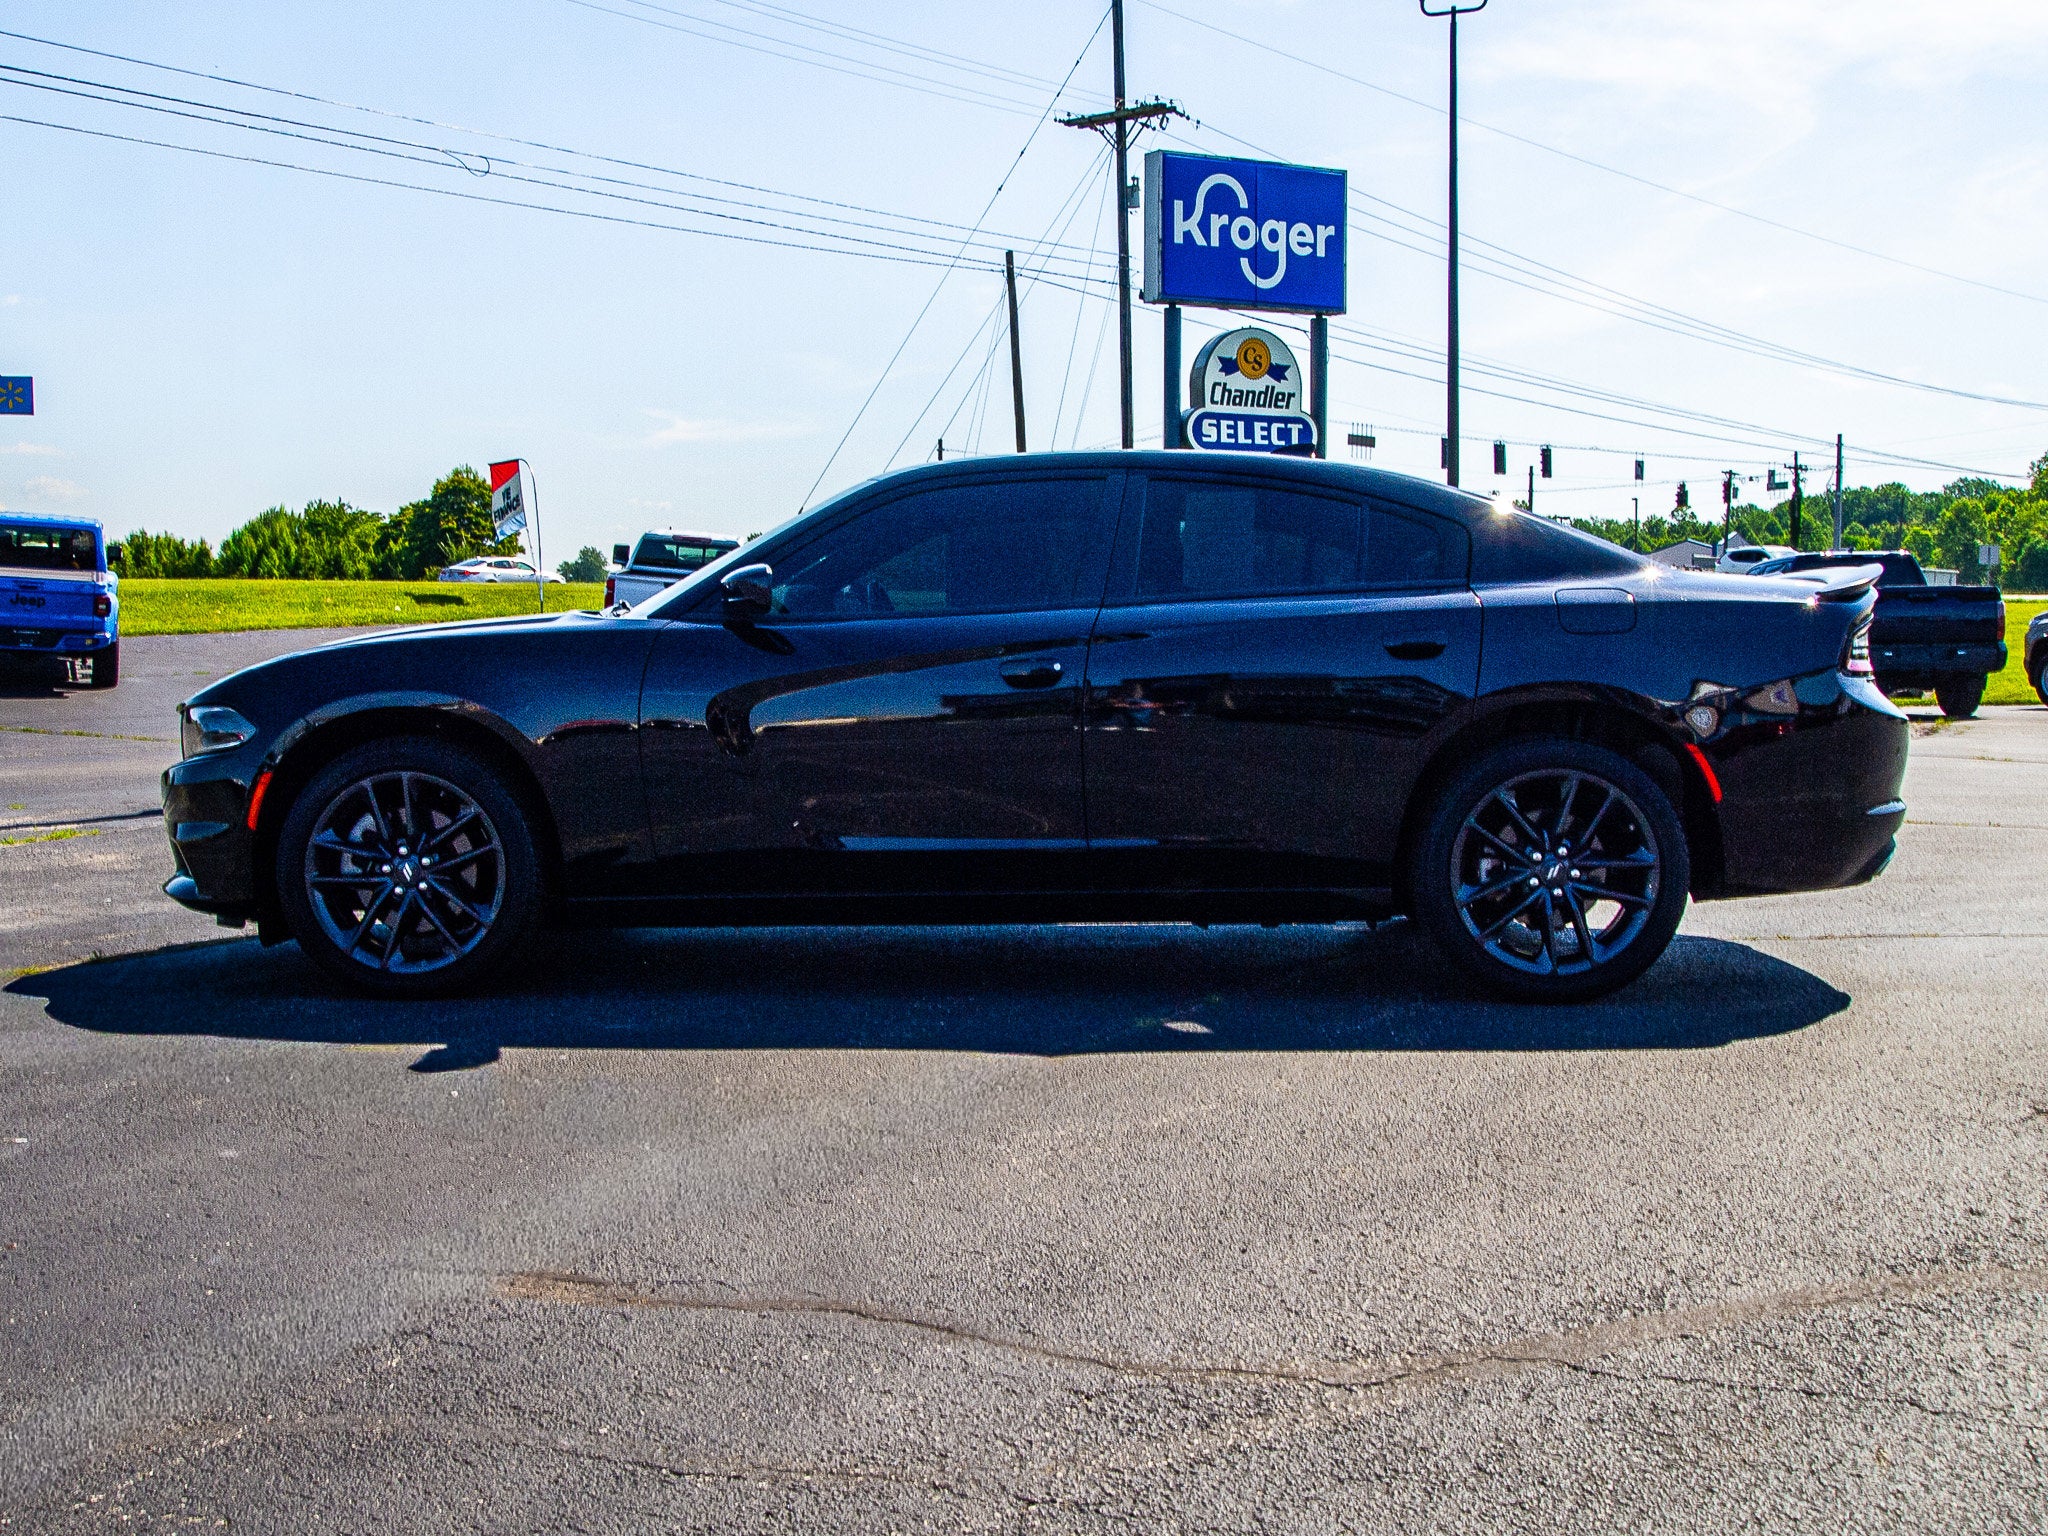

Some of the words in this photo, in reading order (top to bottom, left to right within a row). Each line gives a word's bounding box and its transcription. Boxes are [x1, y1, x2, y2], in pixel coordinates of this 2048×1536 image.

[1173, 173, 1335, 289] Kroger
[1209, 381, 1296, 410] Chandler
[1201, 418, 1304, 447] SELECT
[10, 593, 46, 608] Jeep
